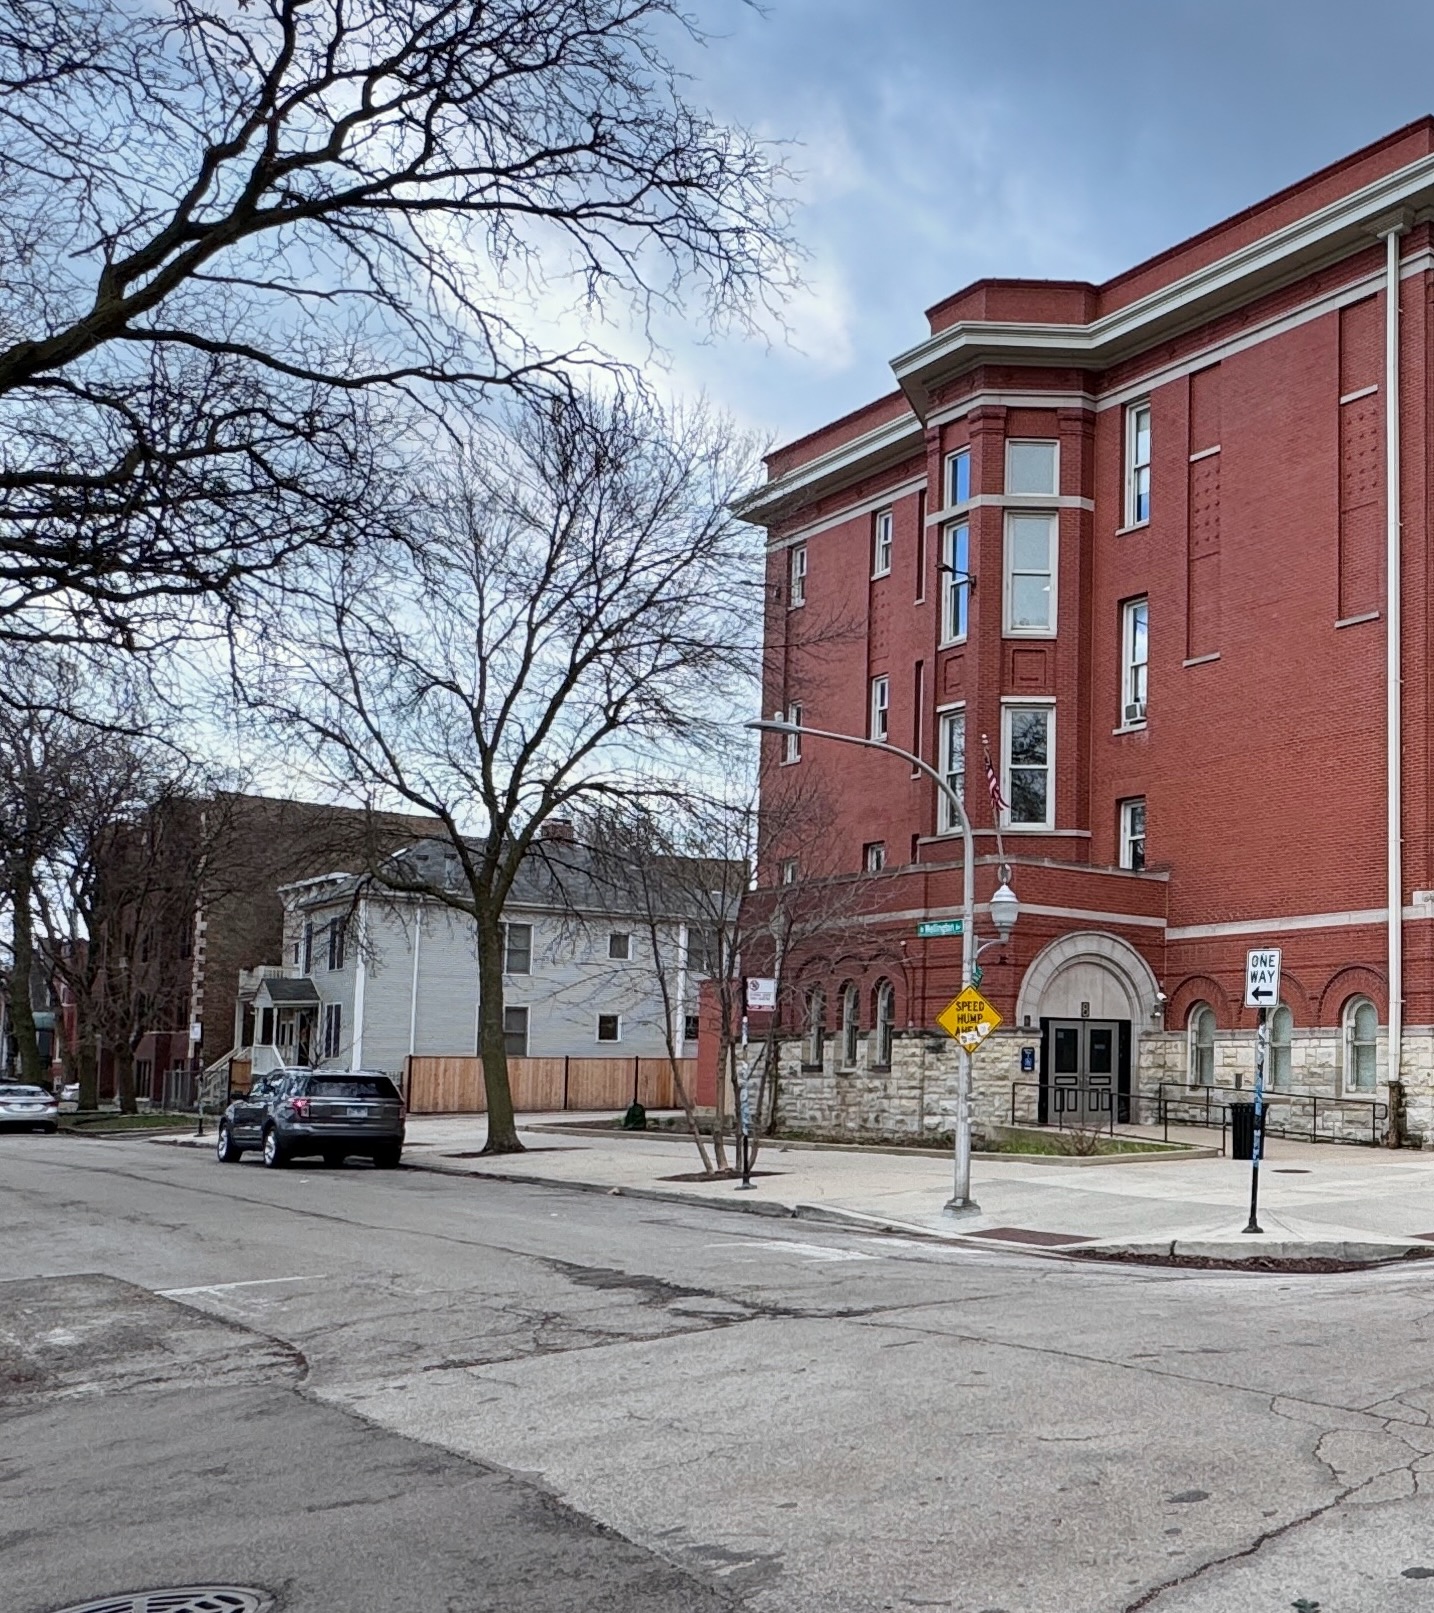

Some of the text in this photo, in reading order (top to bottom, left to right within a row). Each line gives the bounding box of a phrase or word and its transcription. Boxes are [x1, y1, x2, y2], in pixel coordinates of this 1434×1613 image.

[1252, 955, 1276, 968] ONE
[1251, 970, 1275, 984] WAY
[955, 1001, 985, 1012] SPEED
[957, 1013, 983, 1024] HUMP
